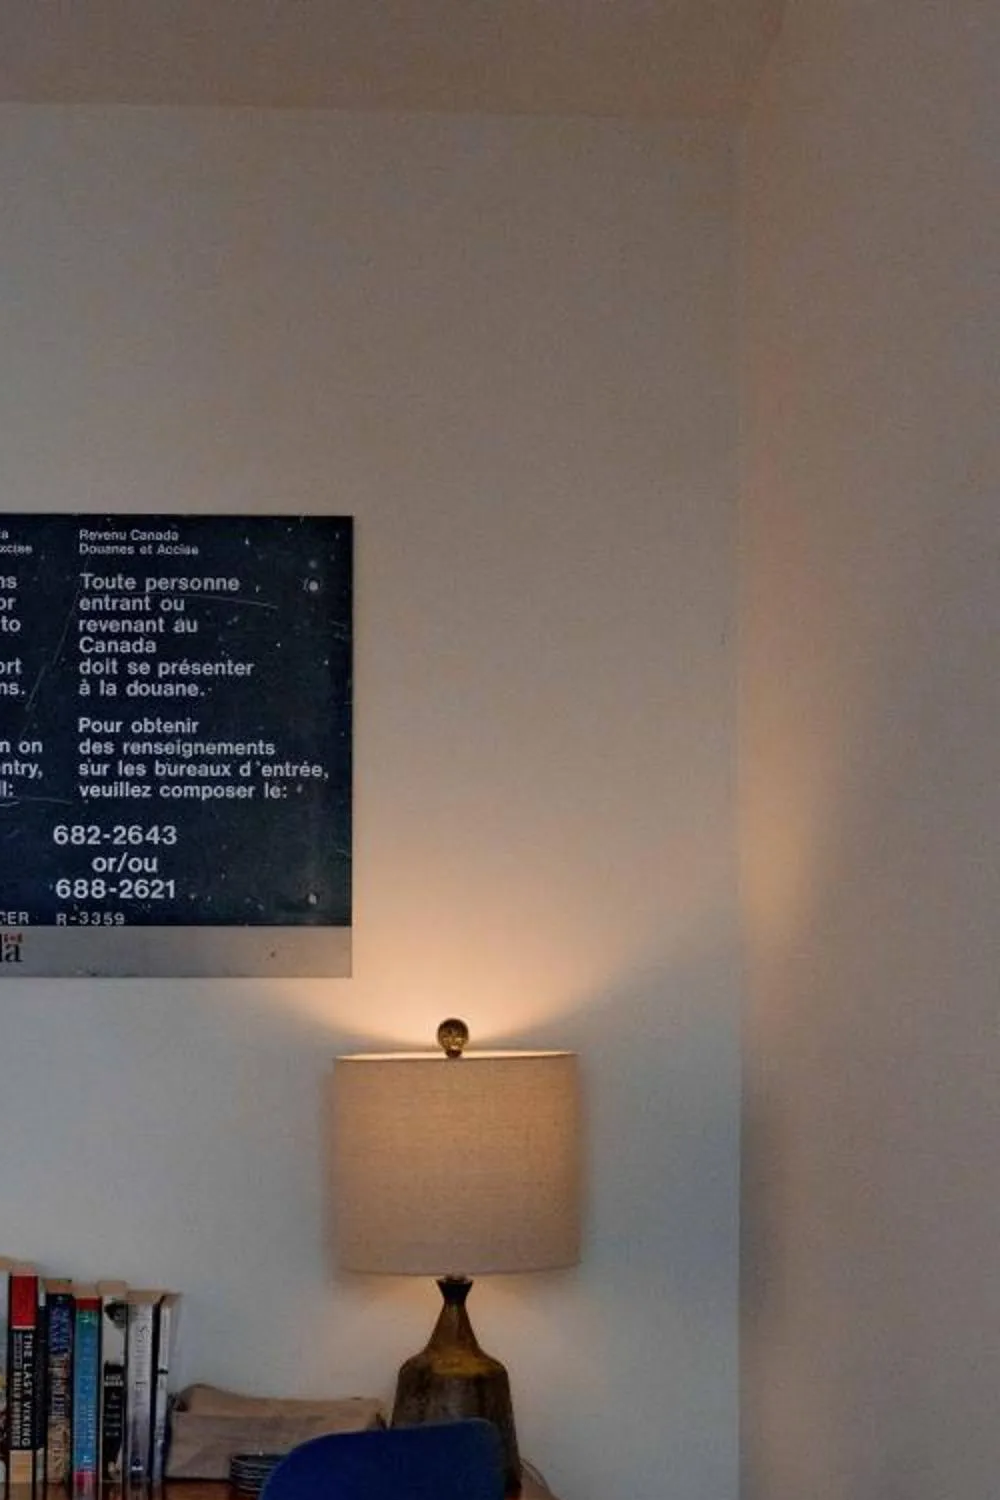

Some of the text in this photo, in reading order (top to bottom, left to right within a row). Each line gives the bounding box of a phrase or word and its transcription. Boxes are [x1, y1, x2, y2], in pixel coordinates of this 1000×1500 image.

[79, 529, 179, 542] Revenu Canada
[79, 544, 199, 556] Douanes et Accise
[79, 573, 241, 596] Toute personne
[79, 595, 185, 612] entrant ou
[1, 615, 21, 632] to
[78, 618, 199, 634] revenant au
[78, 637, 157, 654] Canada
[79, 658, 256, 679] doit se présenter
[78, 679, 206, 697] à la douane.
[78, 717, 200, 734] Pour obtenir
[18, 740, 43, 754] on
[78, 739, 276, 759] des renseignements
[78, 763, 110, 777] sur
[118, 761, 147, 777] les
[154, 761, 232, 777] bureaux
[79, 782, 288, 802] veuillez composer le:
[52, 824, 179, 847] 682-2643
[91, 852, 159, 876] or/ou
[54, 878, 178, 901] 688-2621
[55, 911, 126, 927] R-3359
[21, 1331, 34, 1447] THE LAST VIKING
